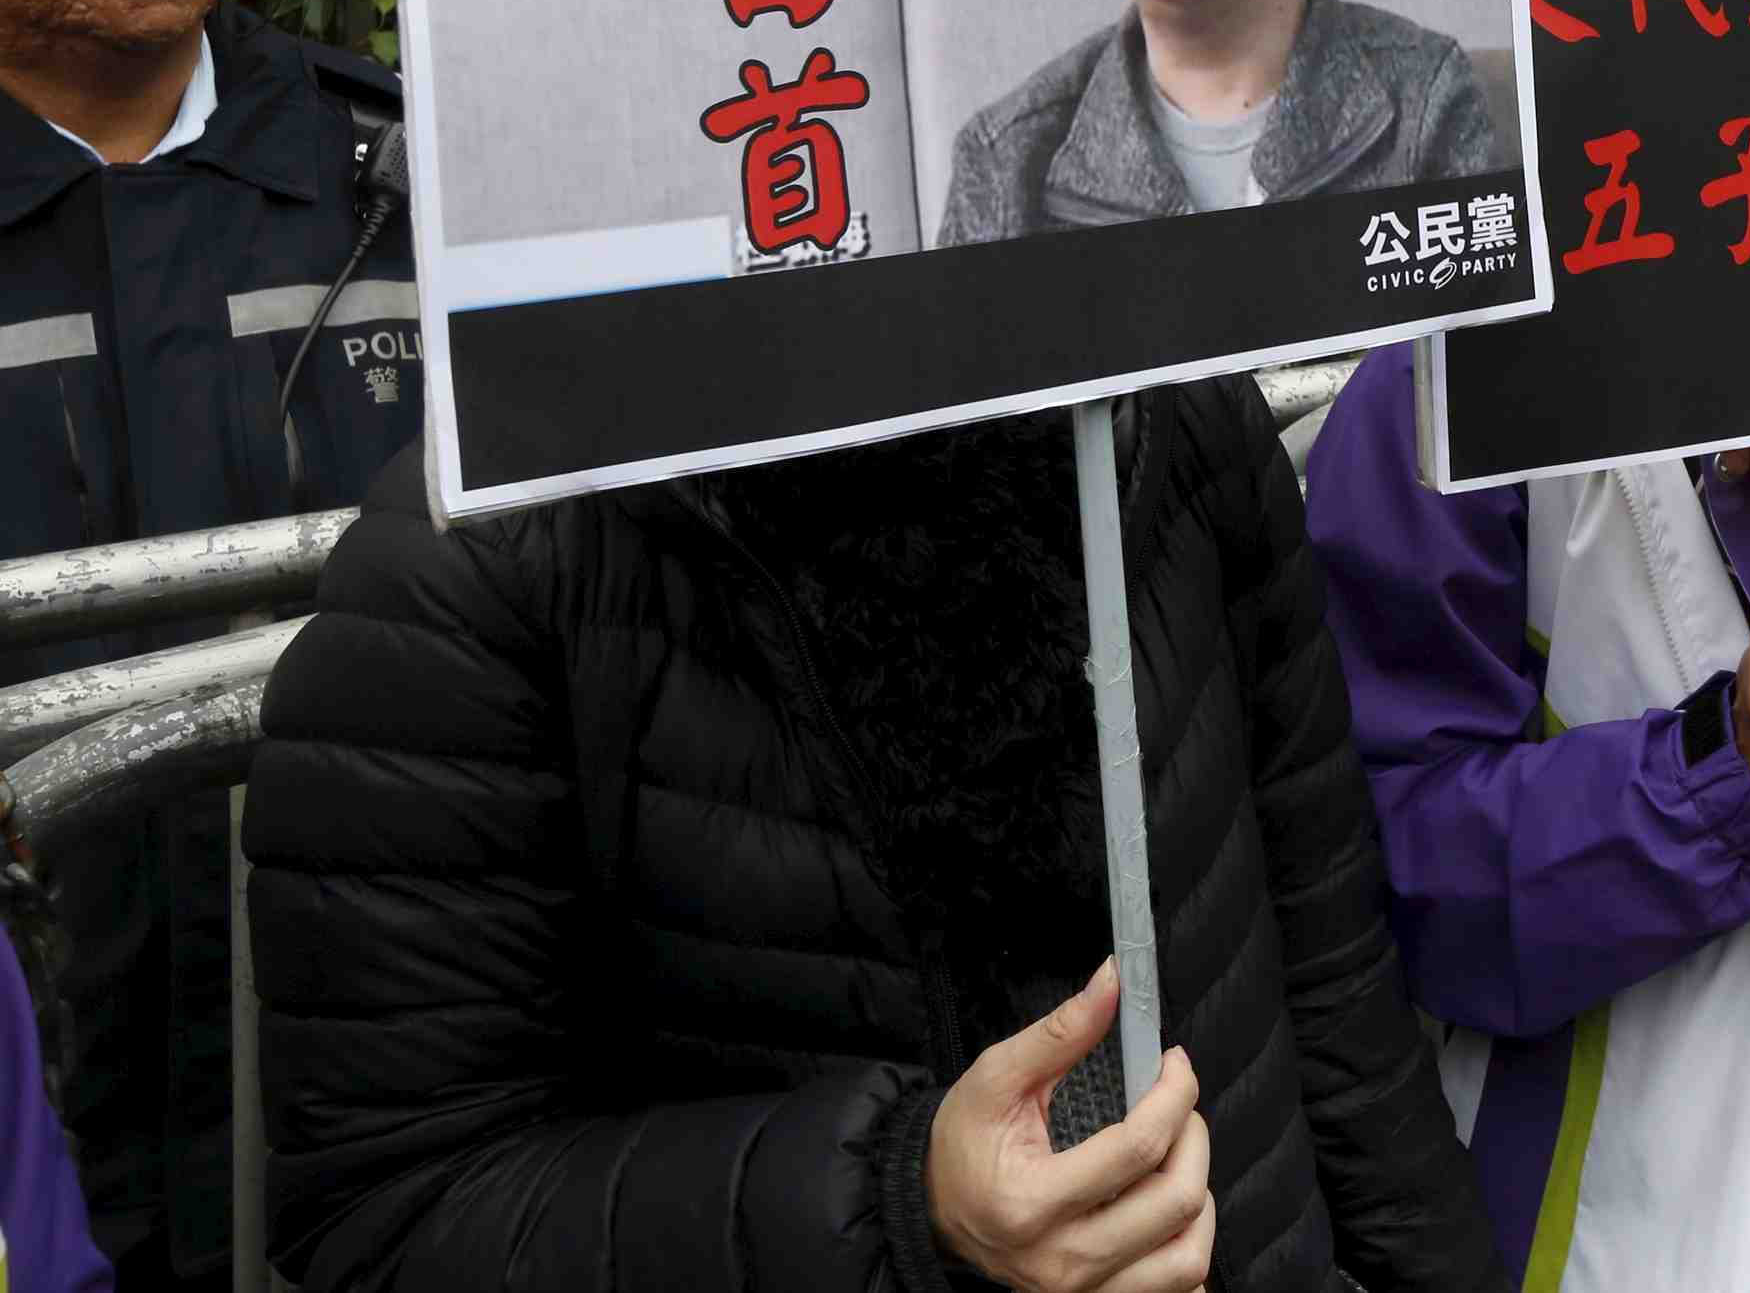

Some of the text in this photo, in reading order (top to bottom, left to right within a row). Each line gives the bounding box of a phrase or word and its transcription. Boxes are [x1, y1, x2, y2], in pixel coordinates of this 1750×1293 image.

[1359, 193, 1517, 266] 公民黨
[1367, 252, 1517, 292] CIVIC PARTY
